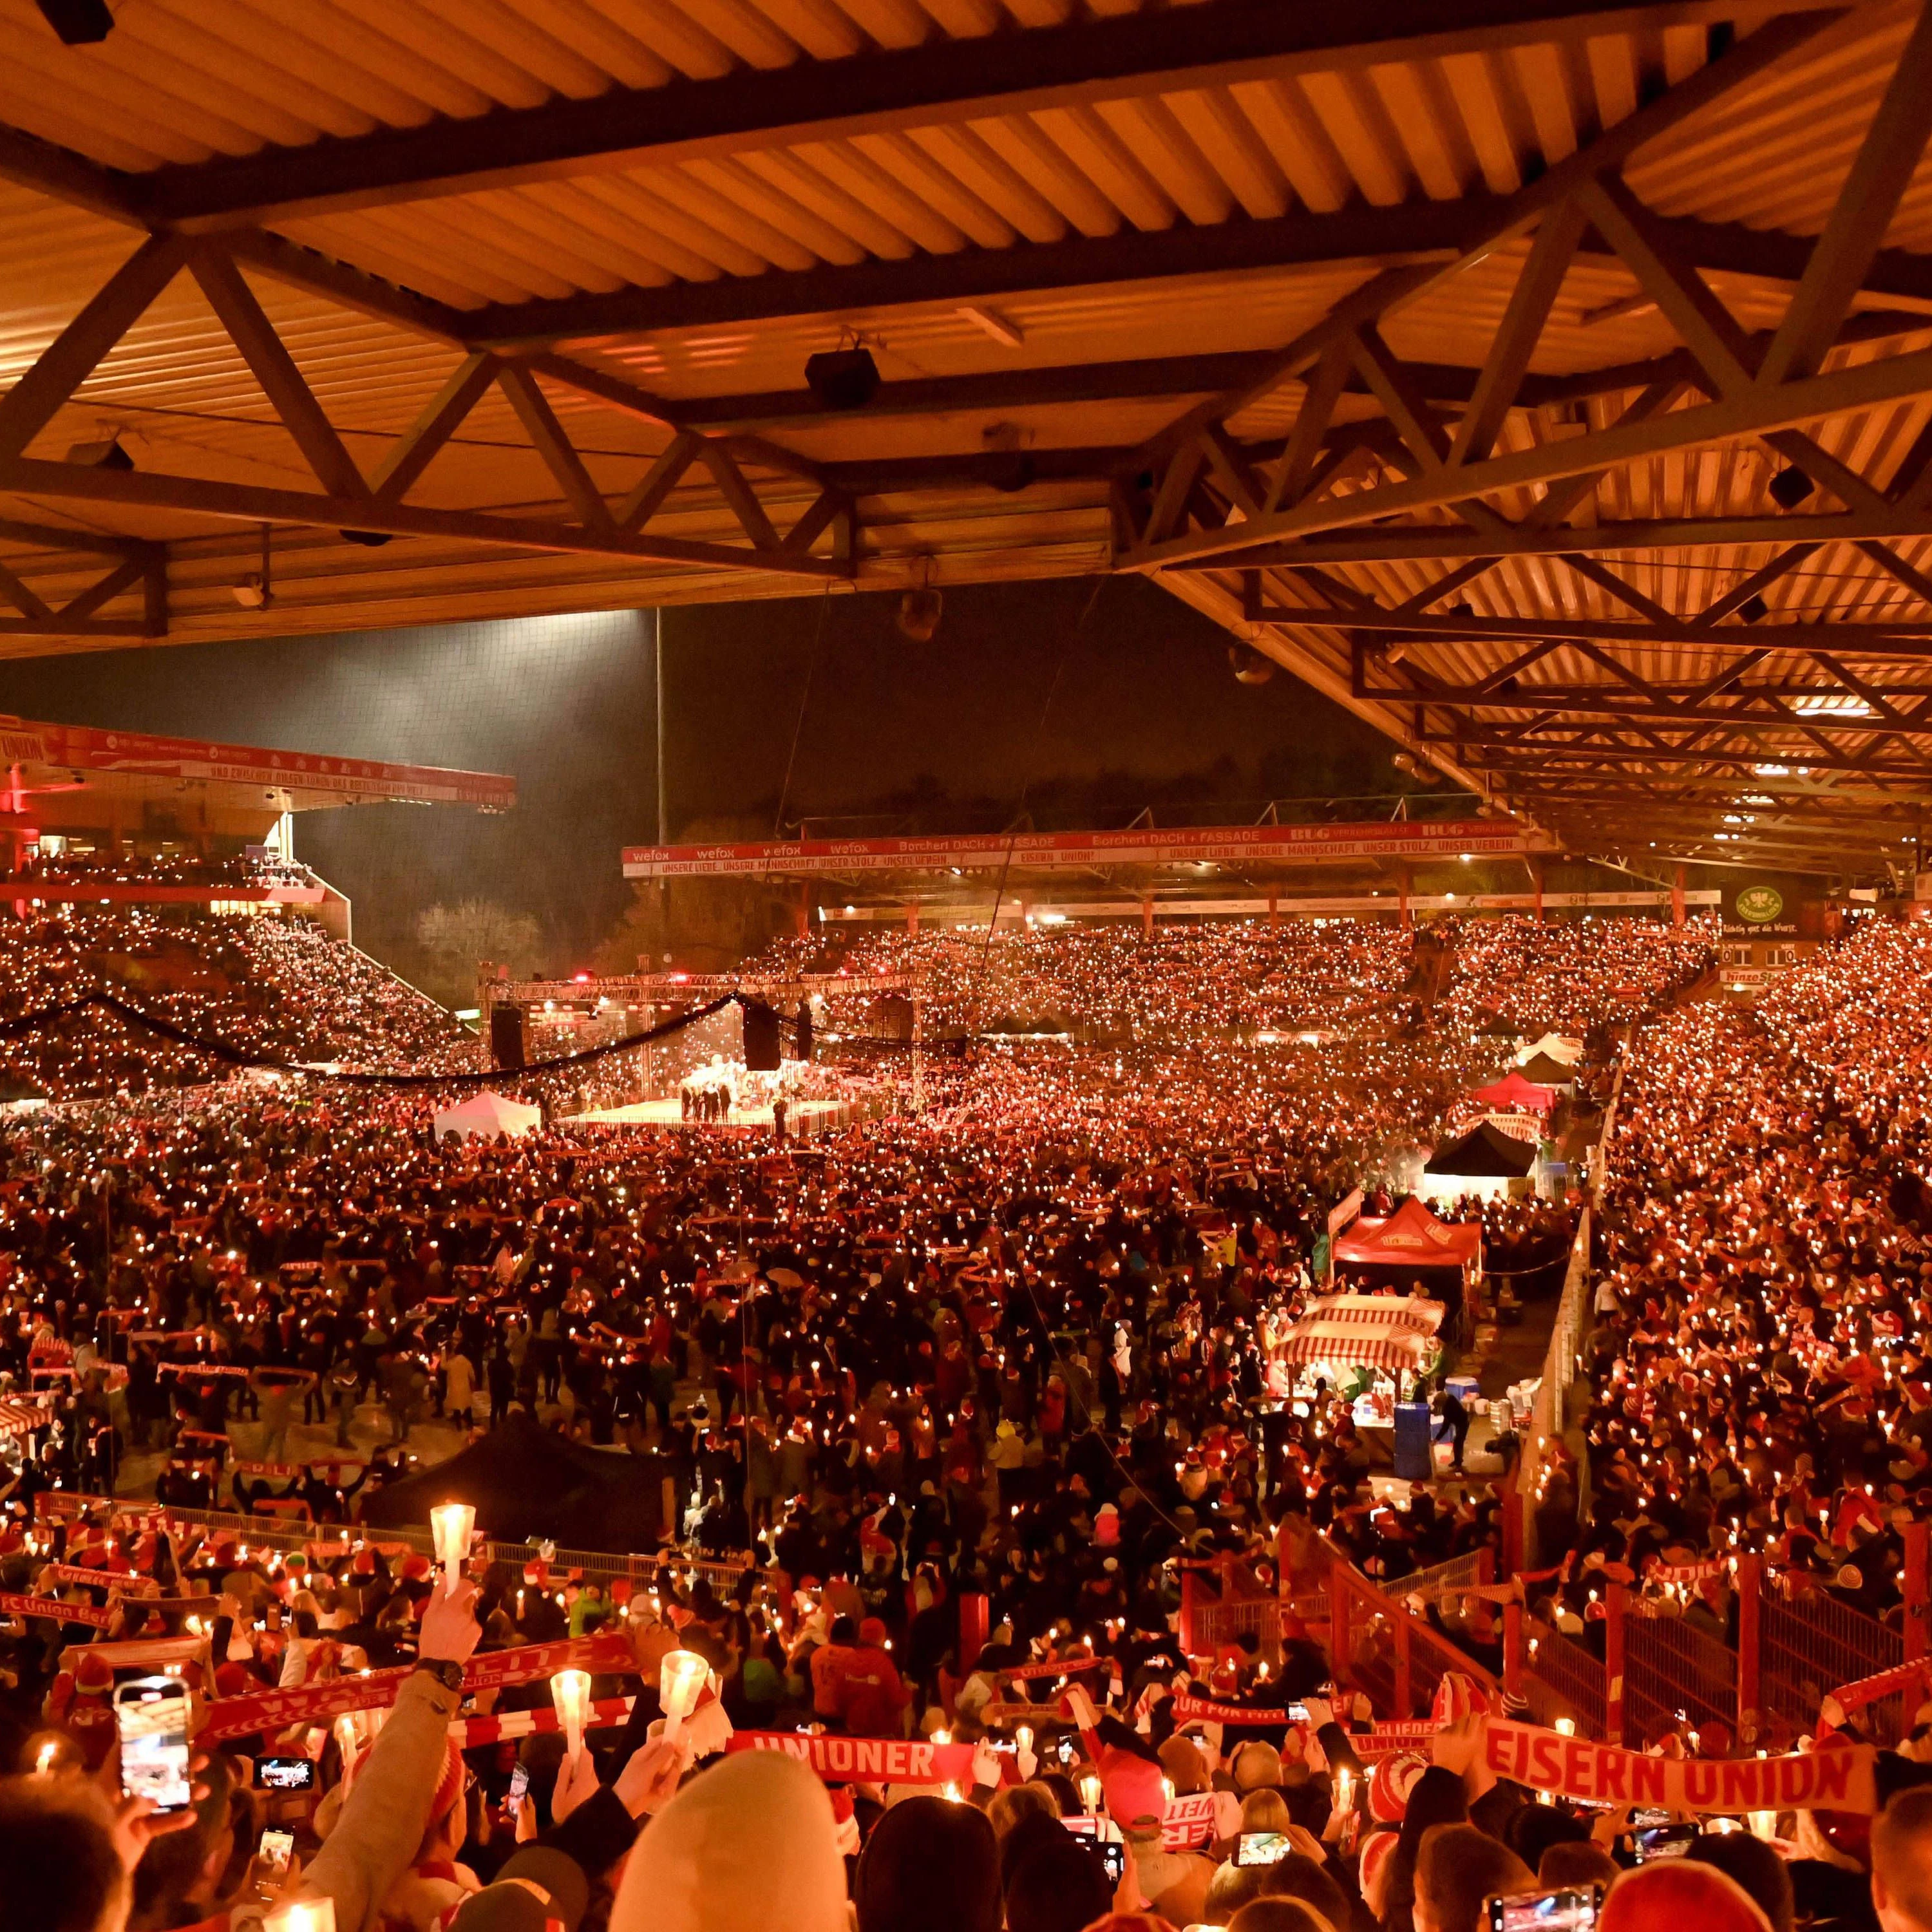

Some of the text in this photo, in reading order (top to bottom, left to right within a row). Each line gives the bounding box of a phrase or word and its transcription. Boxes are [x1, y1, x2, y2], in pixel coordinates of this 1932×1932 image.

[953, 839, 985, 849] DACH
[999, 837, 1055, 850] FASSADE
[1150, 833, 1186, 844] DACH
[1200, 831, 1260, 842] FASSADE
[634, 841, 869, 862] wefox wefox wefox wefox
[1170, 847, 1208, 858] UNSERE
[1245, 845, 1283, 857] UNSERE
[1363, 840, 1396, 853] UNSER
[1438, 839, 1472, 851] UNSER
[662, 864, 693, 873] UNSERE
[723, 861, 754, 871] UNSERE
[820, 856, 848, 867] UNSER
[884, 855, 913, 867] UNSER
[1723, 951, 1730, 961] 0
[1786, 951, 1794, 961] 0
[24, 1599, 73, 1617] Union
[78, 1607, 111, 1625] Ber
[1484, 1728, 1853, 1811] EISERN UNION
